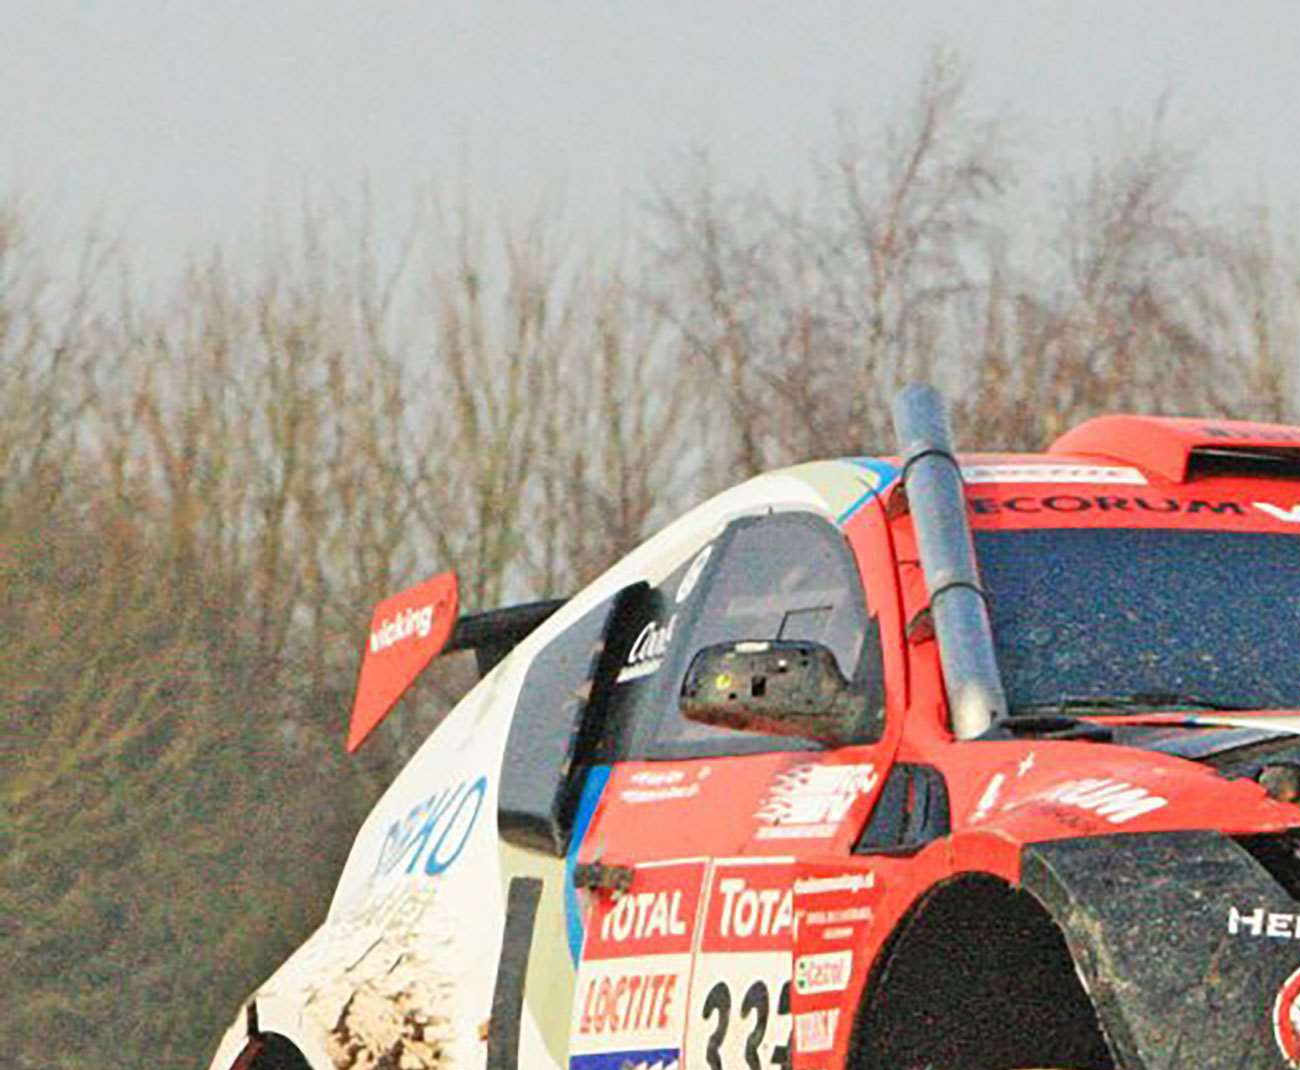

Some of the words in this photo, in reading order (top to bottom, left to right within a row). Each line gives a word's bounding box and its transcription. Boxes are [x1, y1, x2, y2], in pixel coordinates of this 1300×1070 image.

[974, 496, 1247, 514] ECORUM
[720, 877, 793, 937] TOTA
[579, 974, 678, 1034] LOCTITE
